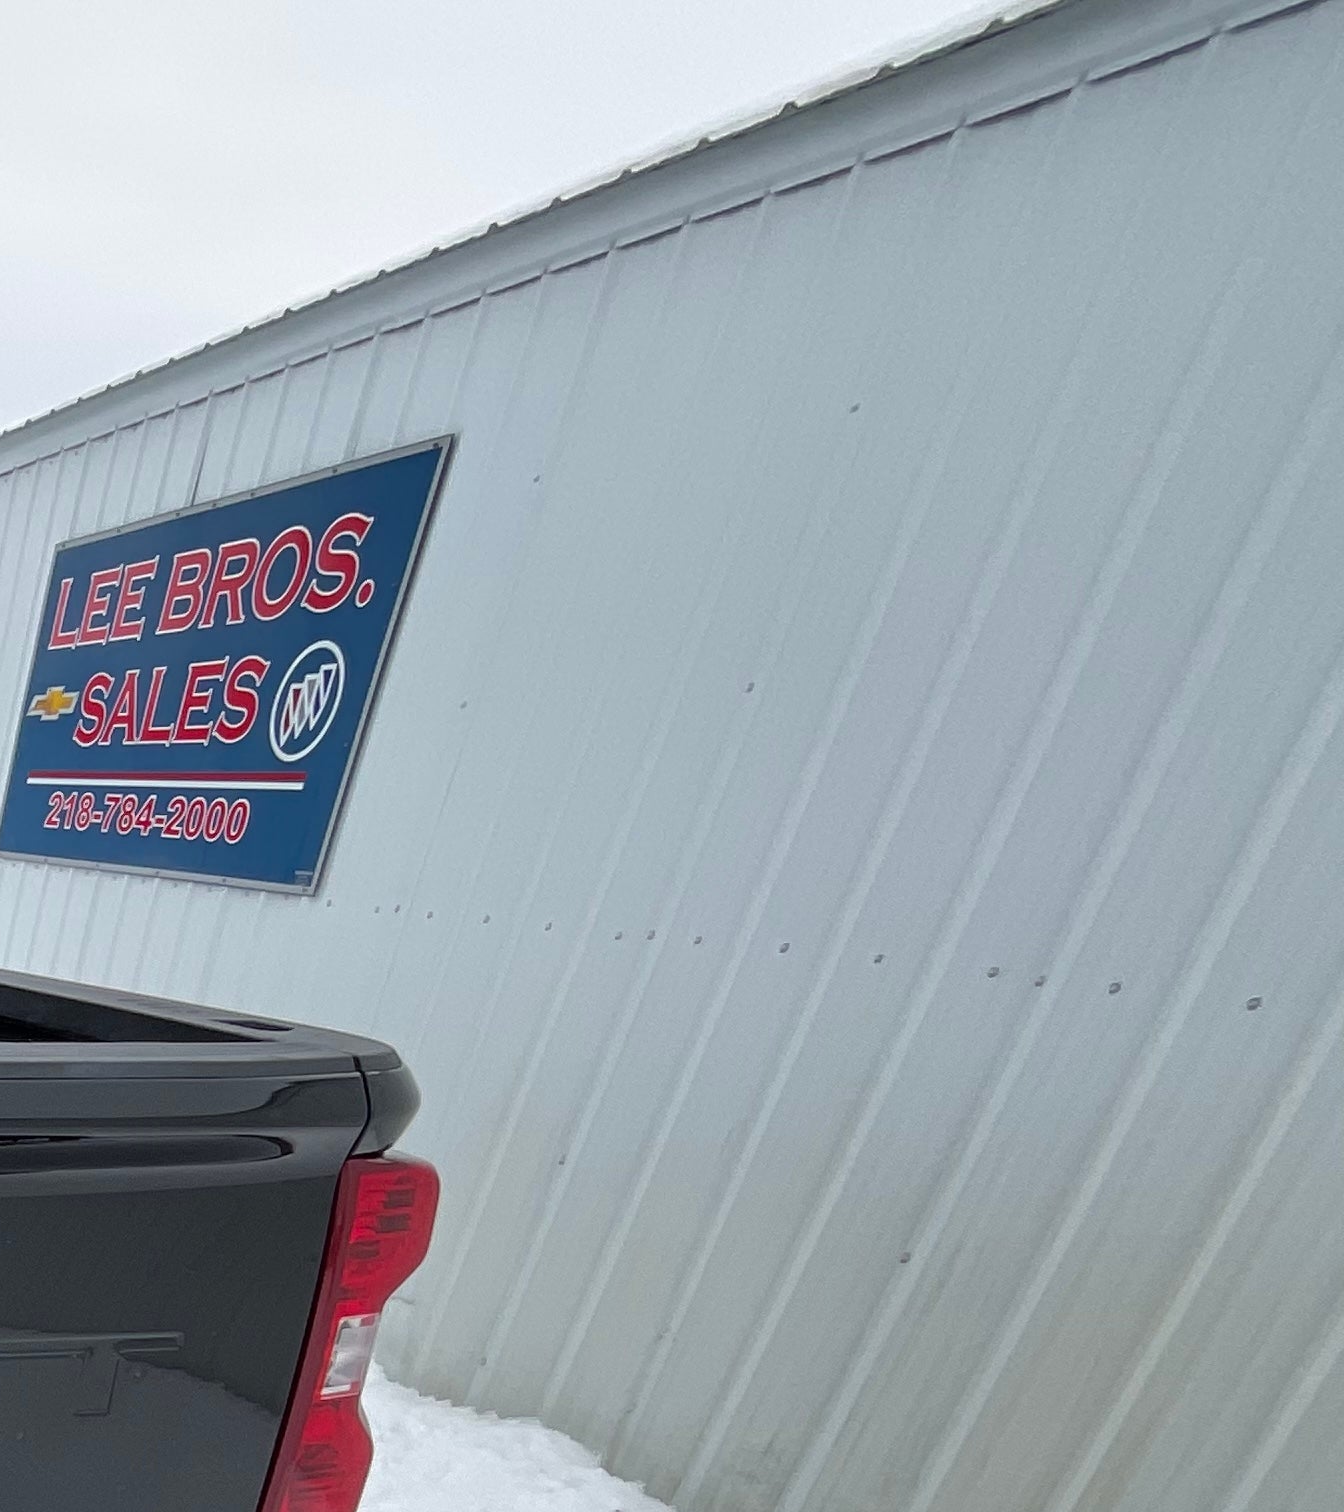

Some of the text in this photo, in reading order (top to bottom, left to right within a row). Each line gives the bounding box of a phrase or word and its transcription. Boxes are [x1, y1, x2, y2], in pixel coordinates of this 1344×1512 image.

[47, 512, 375, 650] LEE BROS.
[72, 656, 271, 747] SALES
[44, 791, 250, 844] 218-784-2000
